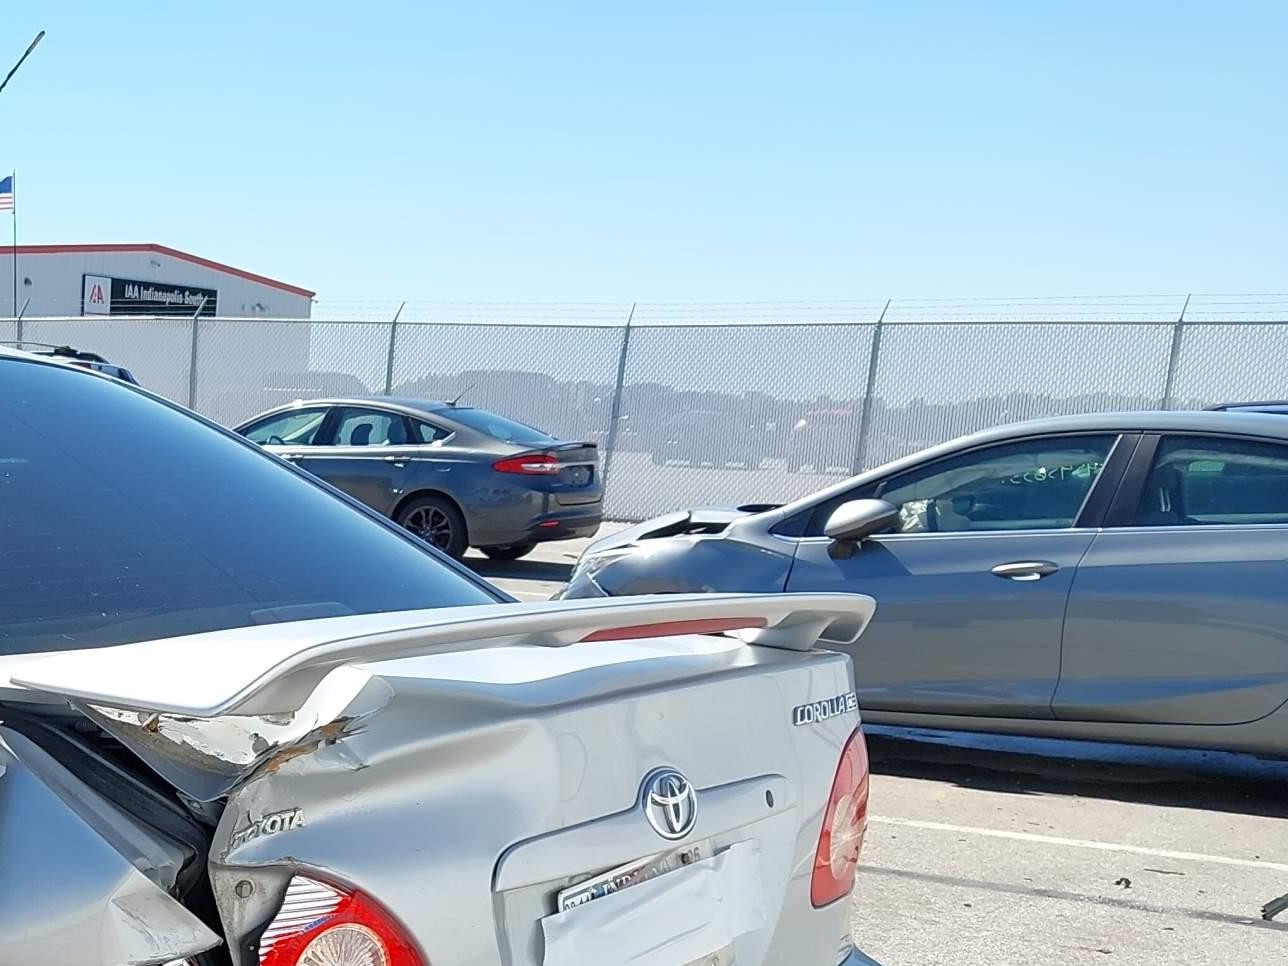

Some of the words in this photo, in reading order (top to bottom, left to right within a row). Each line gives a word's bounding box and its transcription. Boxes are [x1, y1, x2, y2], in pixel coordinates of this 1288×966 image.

[124, 283, 139, 299] IAA
[140, 286, 183, 306] Indianapolis
[184, 290, 204, 306] South
[793, 694, 846, 726] COROLLA
